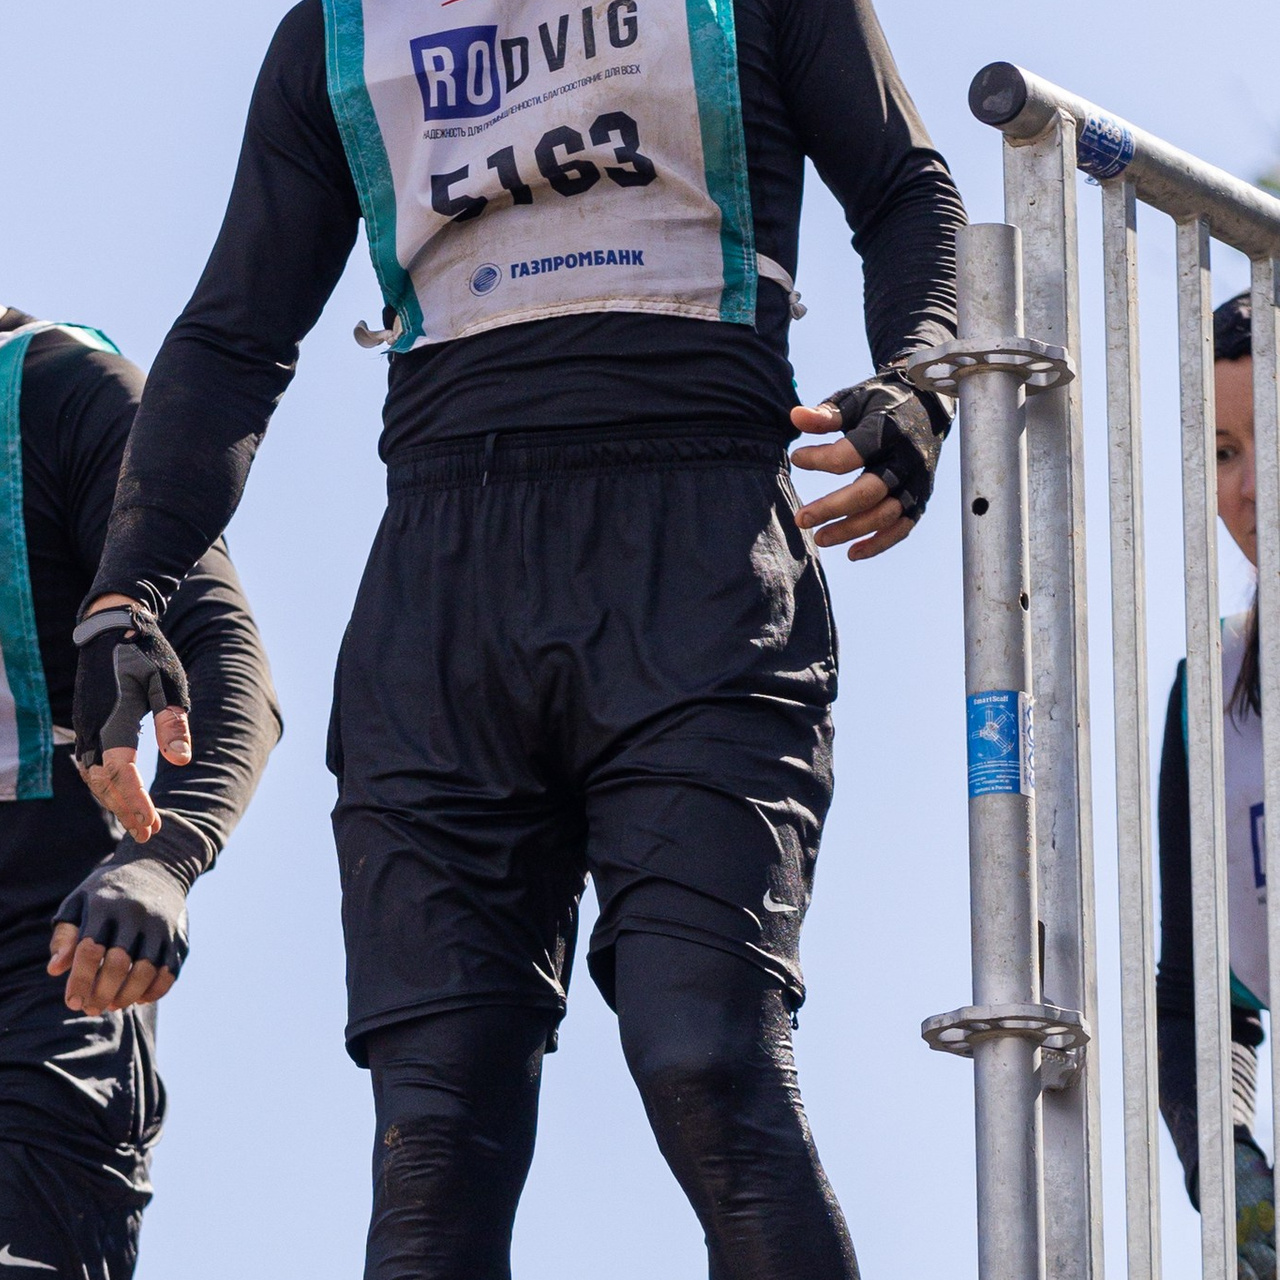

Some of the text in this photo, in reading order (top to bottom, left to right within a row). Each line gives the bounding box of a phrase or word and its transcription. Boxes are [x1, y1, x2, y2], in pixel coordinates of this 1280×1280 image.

[604, 66, 620, 80] ДЛЯ
[621, 64, 641, 76] ВСЕХ
[430, 111, 659, 222] 5163
[509, 249, 645, 280] ГАЗПРОМБАНК
